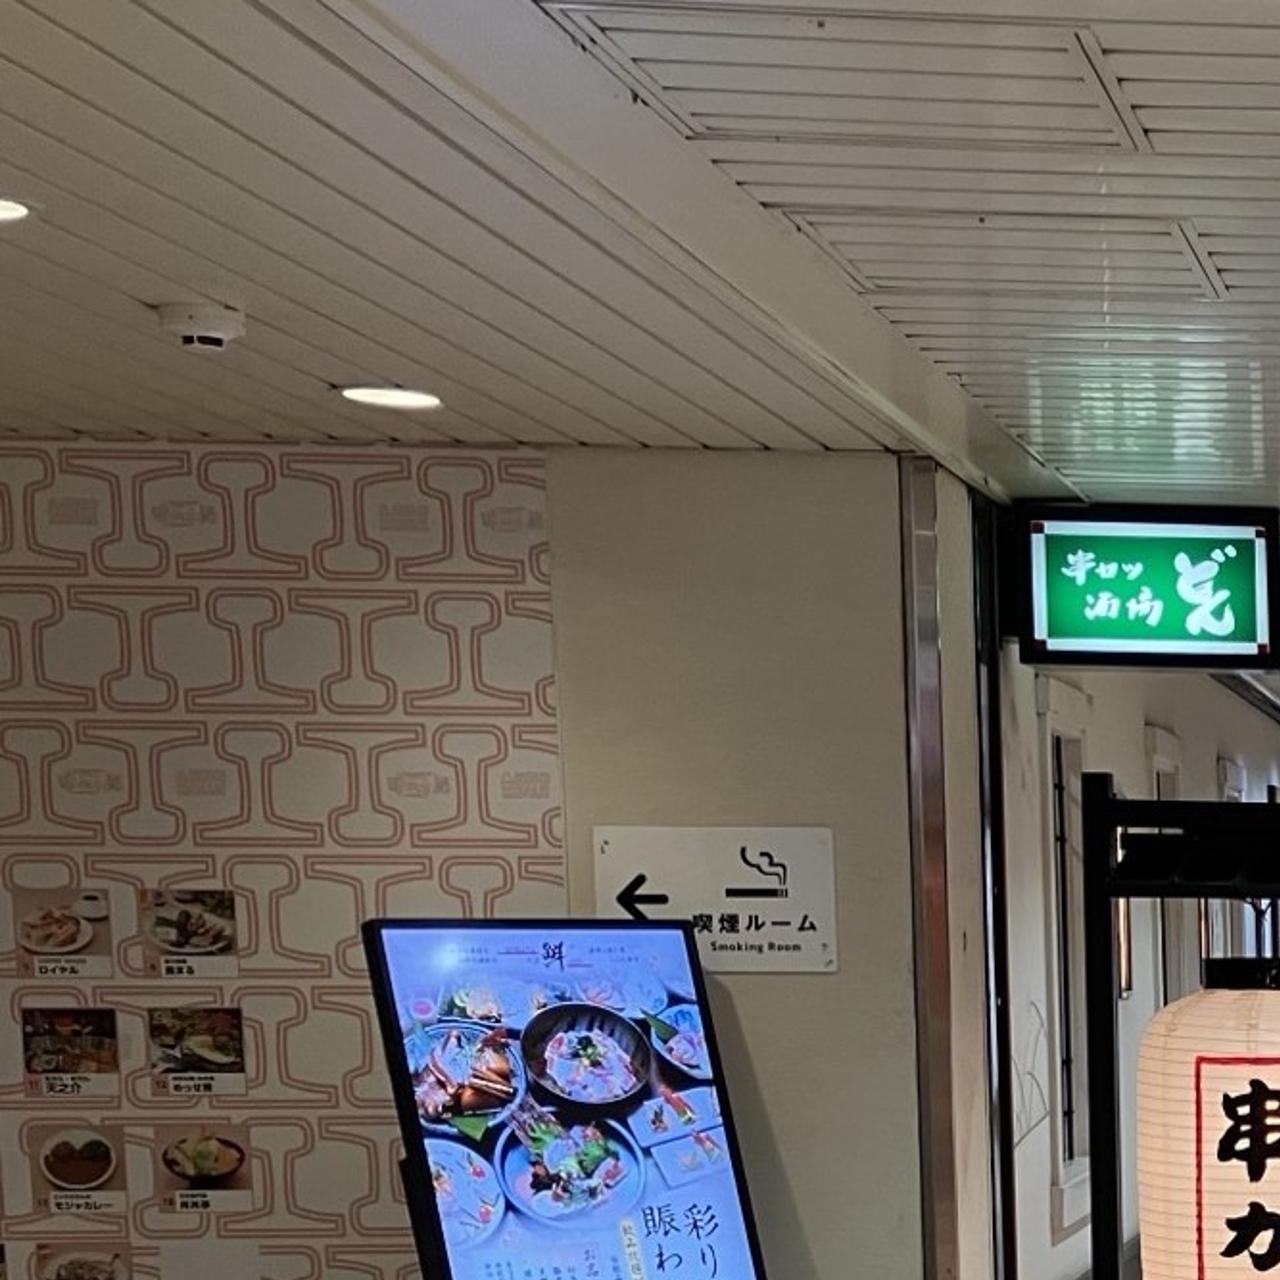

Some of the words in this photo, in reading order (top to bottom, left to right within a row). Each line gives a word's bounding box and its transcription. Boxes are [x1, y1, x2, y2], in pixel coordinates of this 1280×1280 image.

[1061, 550, 1143, 586] 串カツ
[692, 914, 818, 934] 喫煙ルーム
[710, 940, 764, 954] Smoking
[768, 941, 803, 952] Room
